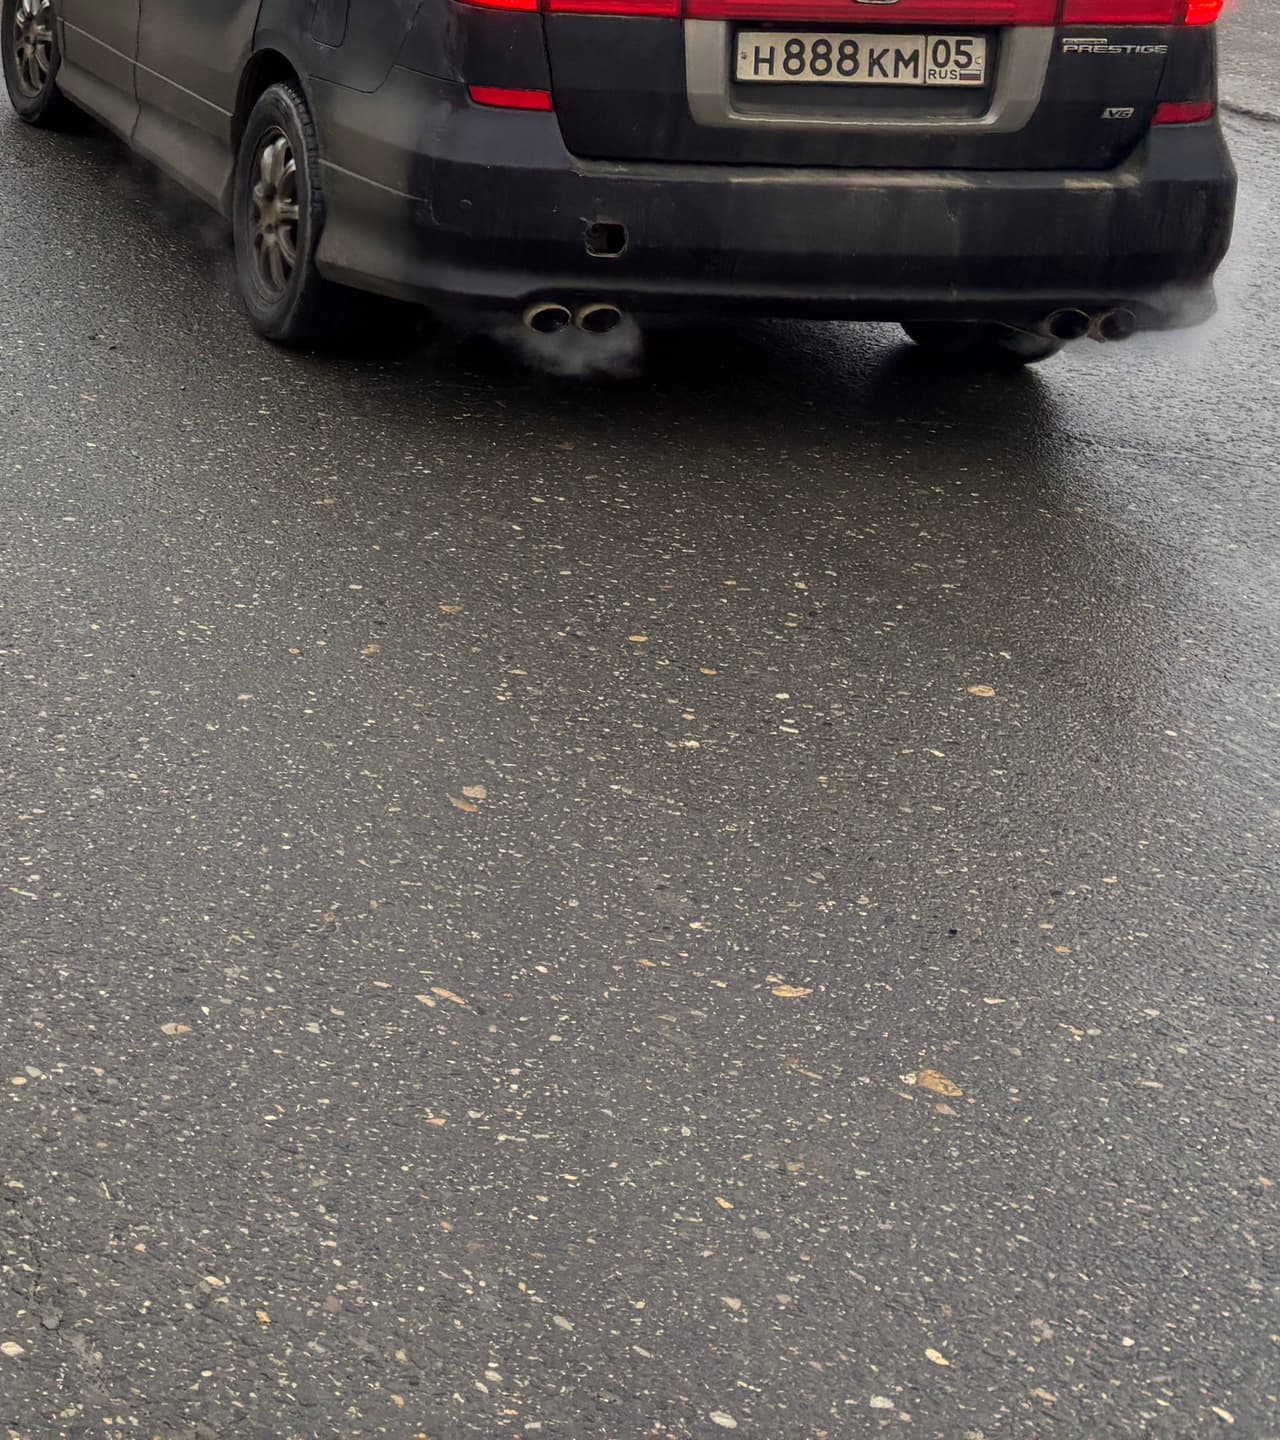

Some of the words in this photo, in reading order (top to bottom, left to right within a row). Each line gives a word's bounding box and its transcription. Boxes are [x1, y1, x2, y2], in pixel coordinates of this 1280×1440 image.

[931, 39, 974, 68] 05
[1063, 45, 1168, 54] PRESTIGE
[928, 69, 958, 80] RUS
